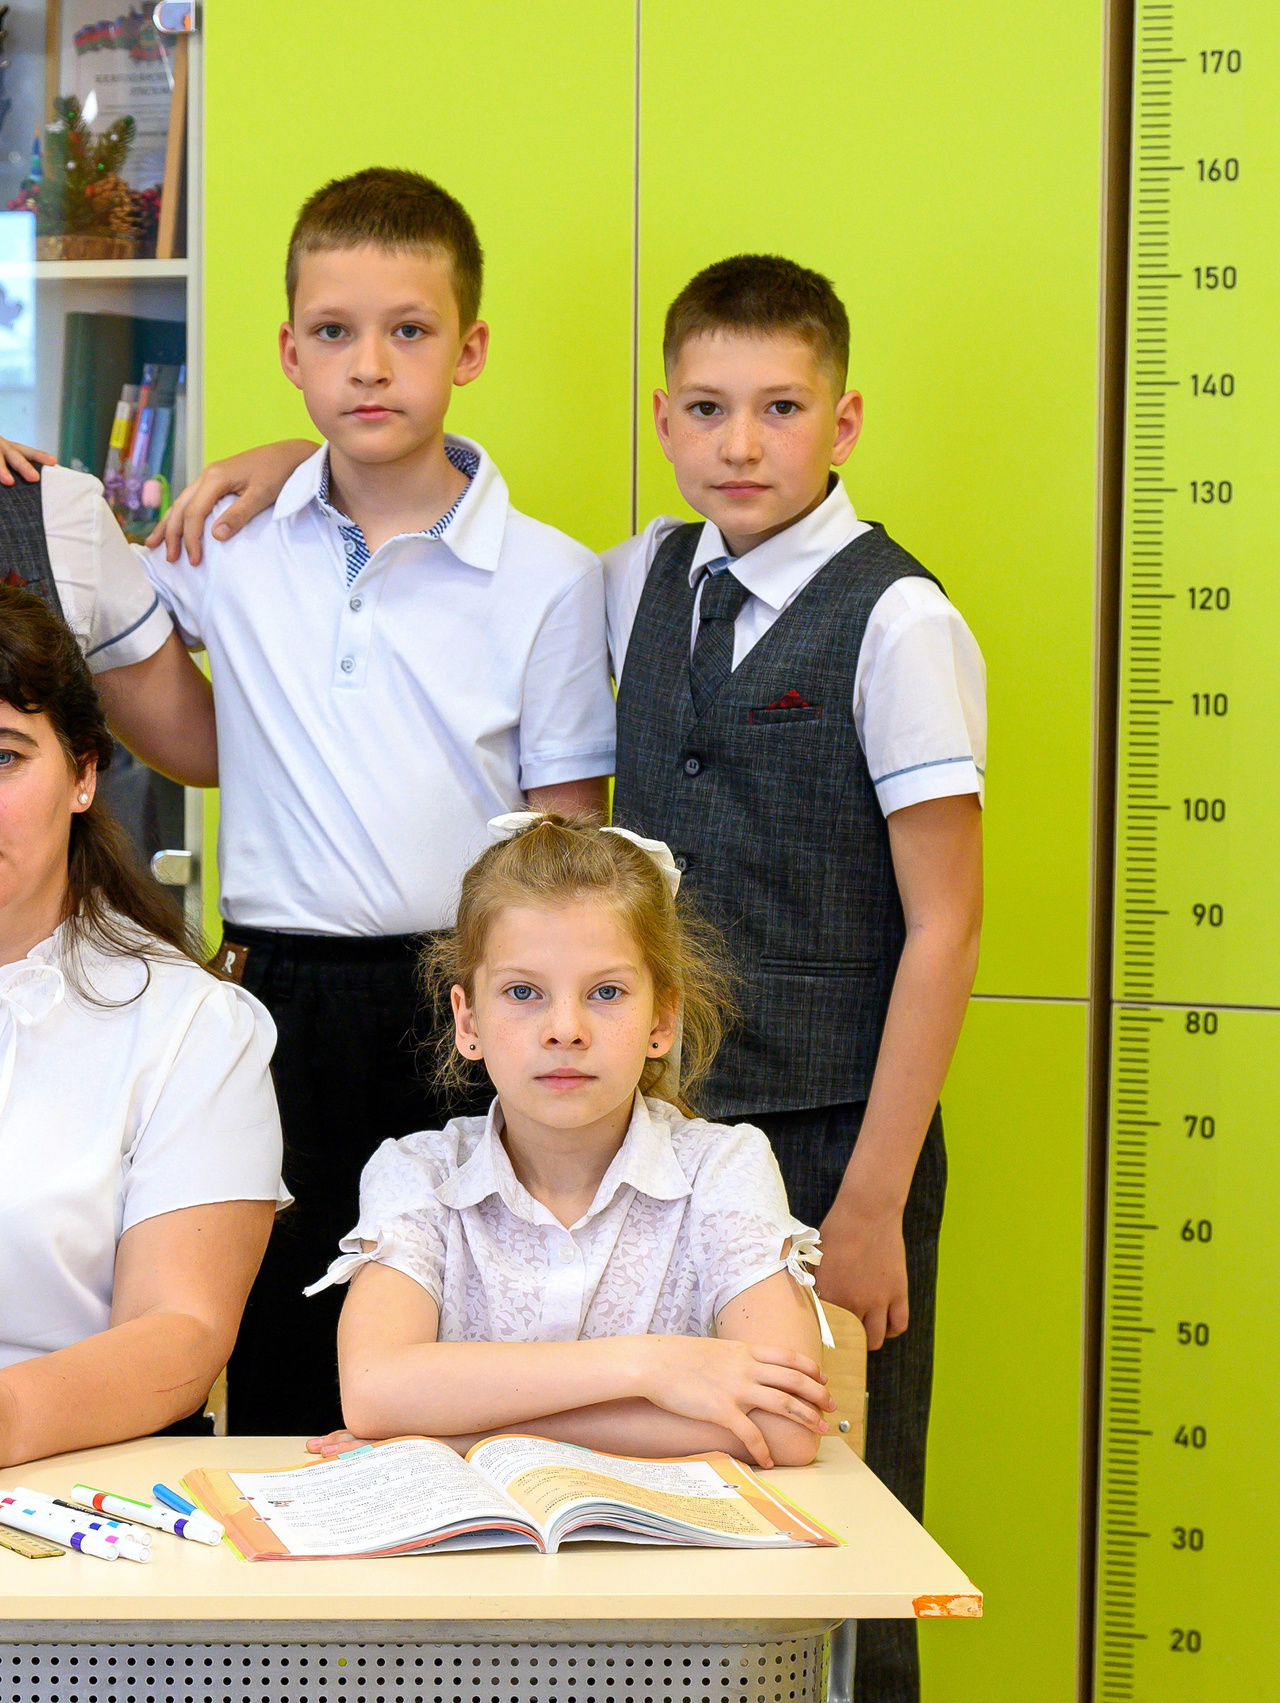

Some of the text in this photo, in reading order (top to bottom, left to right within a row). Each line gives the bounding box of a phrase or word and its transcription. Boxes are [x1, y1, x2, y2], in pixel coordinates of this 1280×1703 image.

[1200, 50, 1241, 73] 170
[1197, 158, 1239, 182] 160
[1194, 266, 1236, 290] 150
[1191, 373, 1234, 397] 140
[1191, 481, 1232, 504] 130
[1189, 587, 1230, 610] 120
[1193, 693, 1228, 716] 110
[1184, 798, 1225, 822] 100
[1193, 903, 1223, 927] 90
[1186, 1011, 1218, 1035] 80
[1184, 1115, 1215, 1139] 70
[1181, 1219, 1212, 1243] 60
[1178, 1322, 1209, 1346] 50
[1174, 1425, 1206, 1449] 40
[1172, 1527, 1203, 1551] 30
[1170, 1628, 1201, 1653] 20
